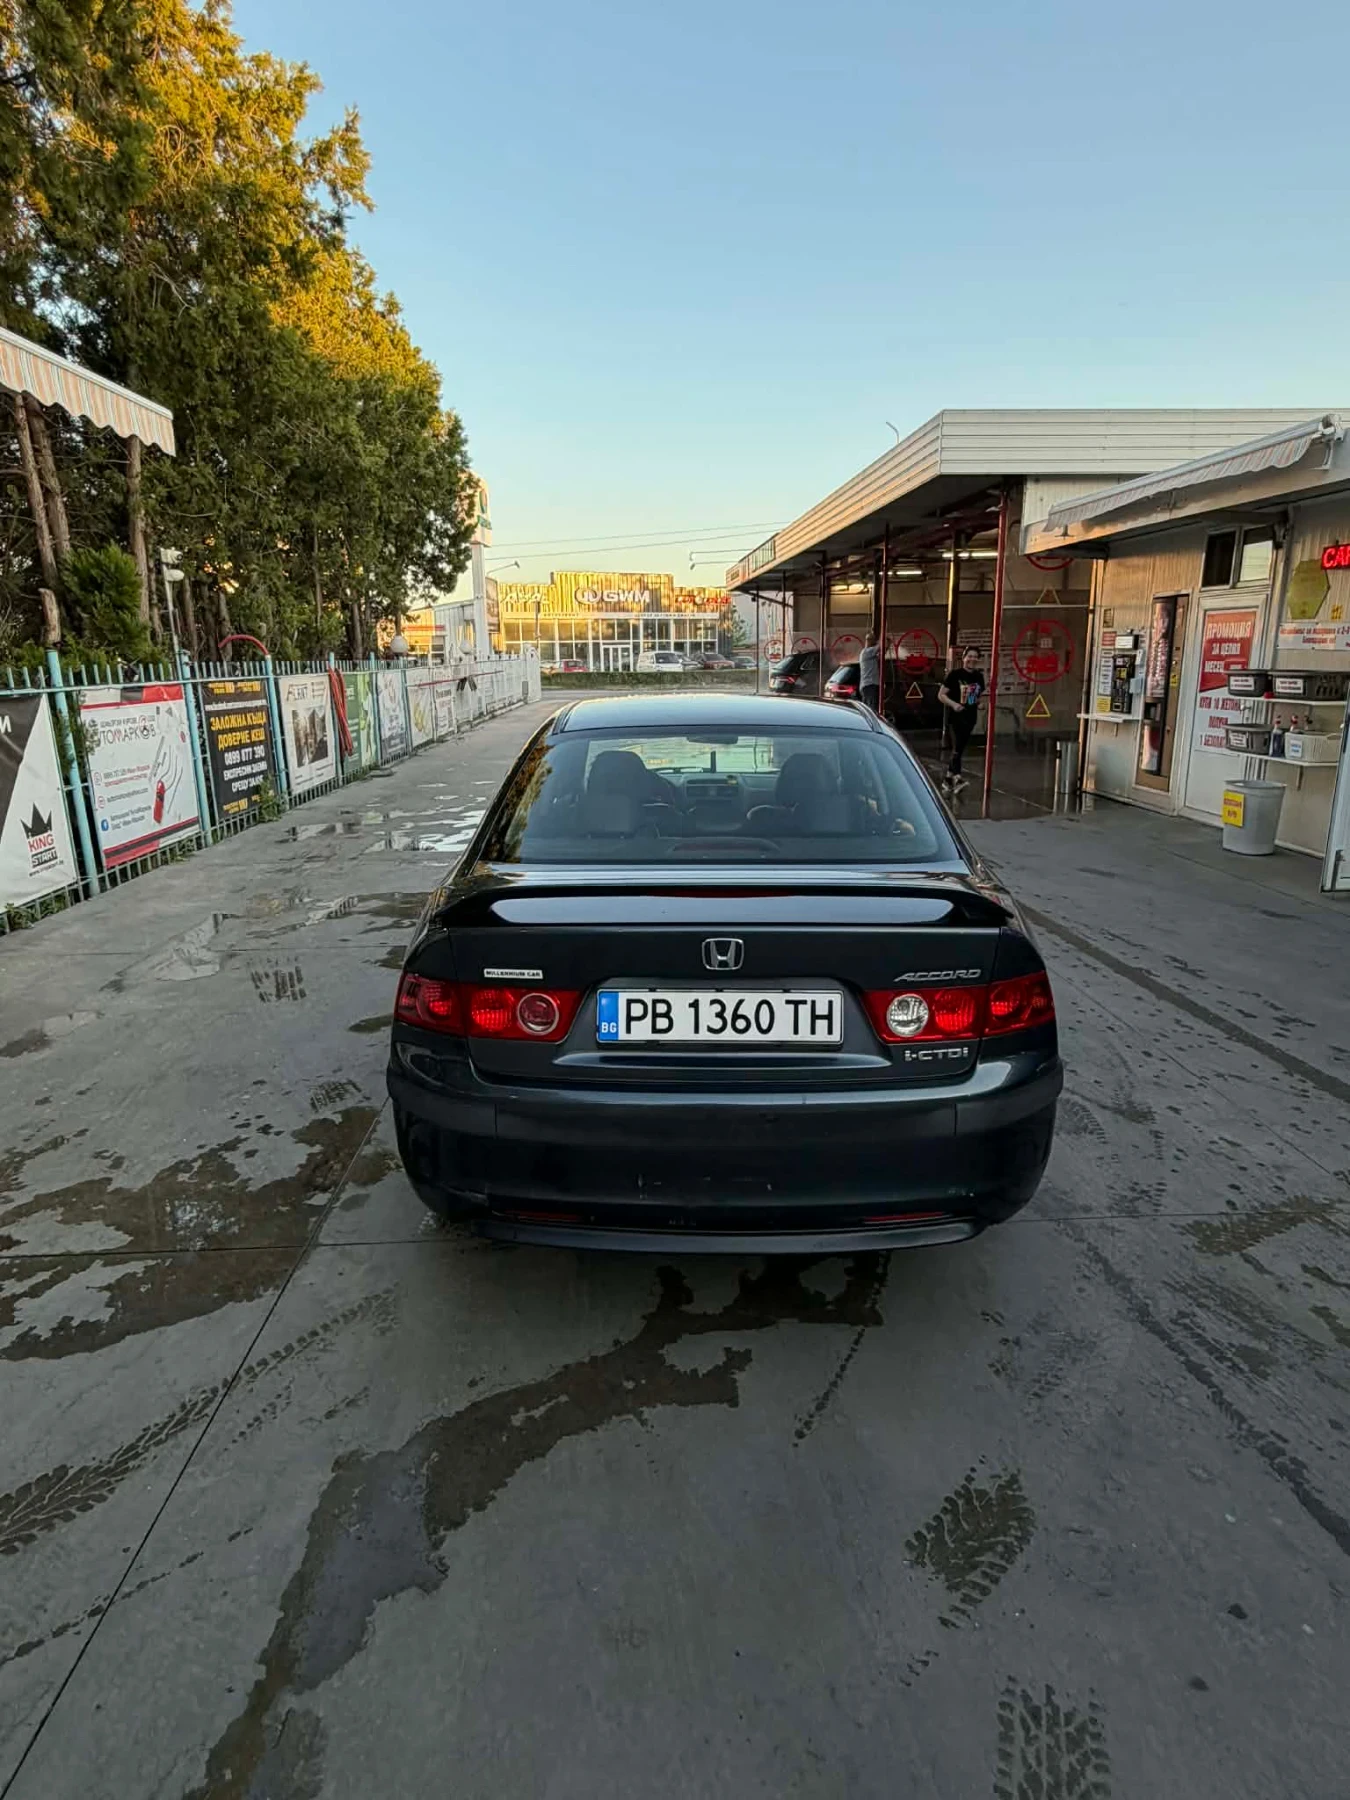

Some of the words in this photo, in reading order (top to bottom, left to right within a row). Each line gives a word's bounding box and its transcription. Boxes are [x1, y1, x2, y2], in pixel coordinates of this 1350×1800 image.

[603, 590, 650, 603] GWM
[1206, 621, 1252, 641] ПРОМОЦИЯ
[1212, 643, 1220, 655] ЗА
[1213, 696, 1220, 710] 10
[210, 713, 247, 731] ЗАЛОЖНА
[217, 730, 250, 752] ДОВЕРИЕ
[224, 750, 240, 766] 0899
[28, 833, 55, 852] KING
[32, 849, 58, 867] START
[893, 969, 982, 982] ACCORD
[601, 1022, 617, 1034] BG
[625, 998, 674, 1035] PB
[688, 998, 775, 1035] 1360
[785, 999, 834, 1036] TH
